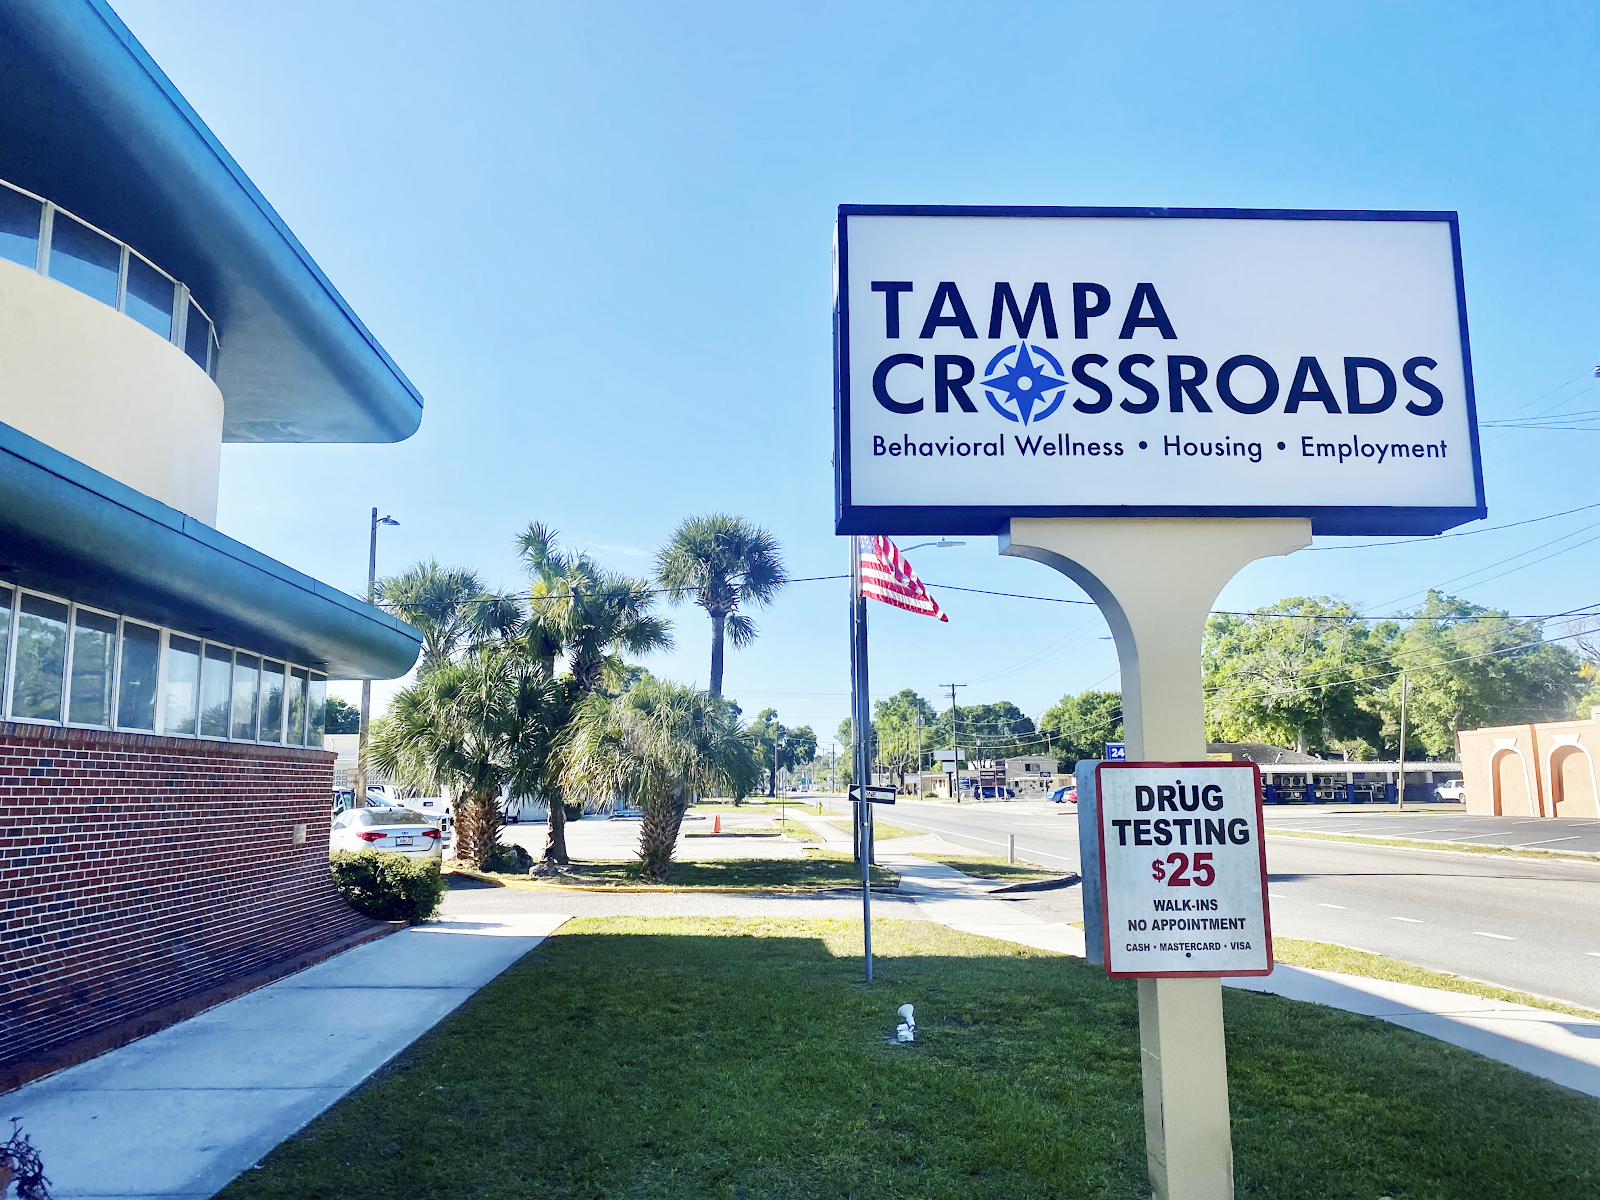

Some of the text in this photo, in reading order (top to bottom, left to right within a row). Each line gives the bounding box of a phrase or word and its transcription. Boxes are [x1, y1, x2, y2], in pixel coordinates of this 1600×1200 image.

[871, 281, 1178, 340] TAMPA
[872, 350, 1444, 419] CROSSROADS
[873, 434, 1448, 464] Behavioral Wellness Housing Employment
[1135, 784, 1224, 811] DRUG
[1112, 818, 1250, 846] TESTING
[1152, 852, 1216, 887] $25
[1153, 899, 1218, 912] WALK-INS
[1128, 918, 1246, 931] NO APPOINTMENT
[1125, 942, 1252, 952] CASH MASTERCARD VISA
